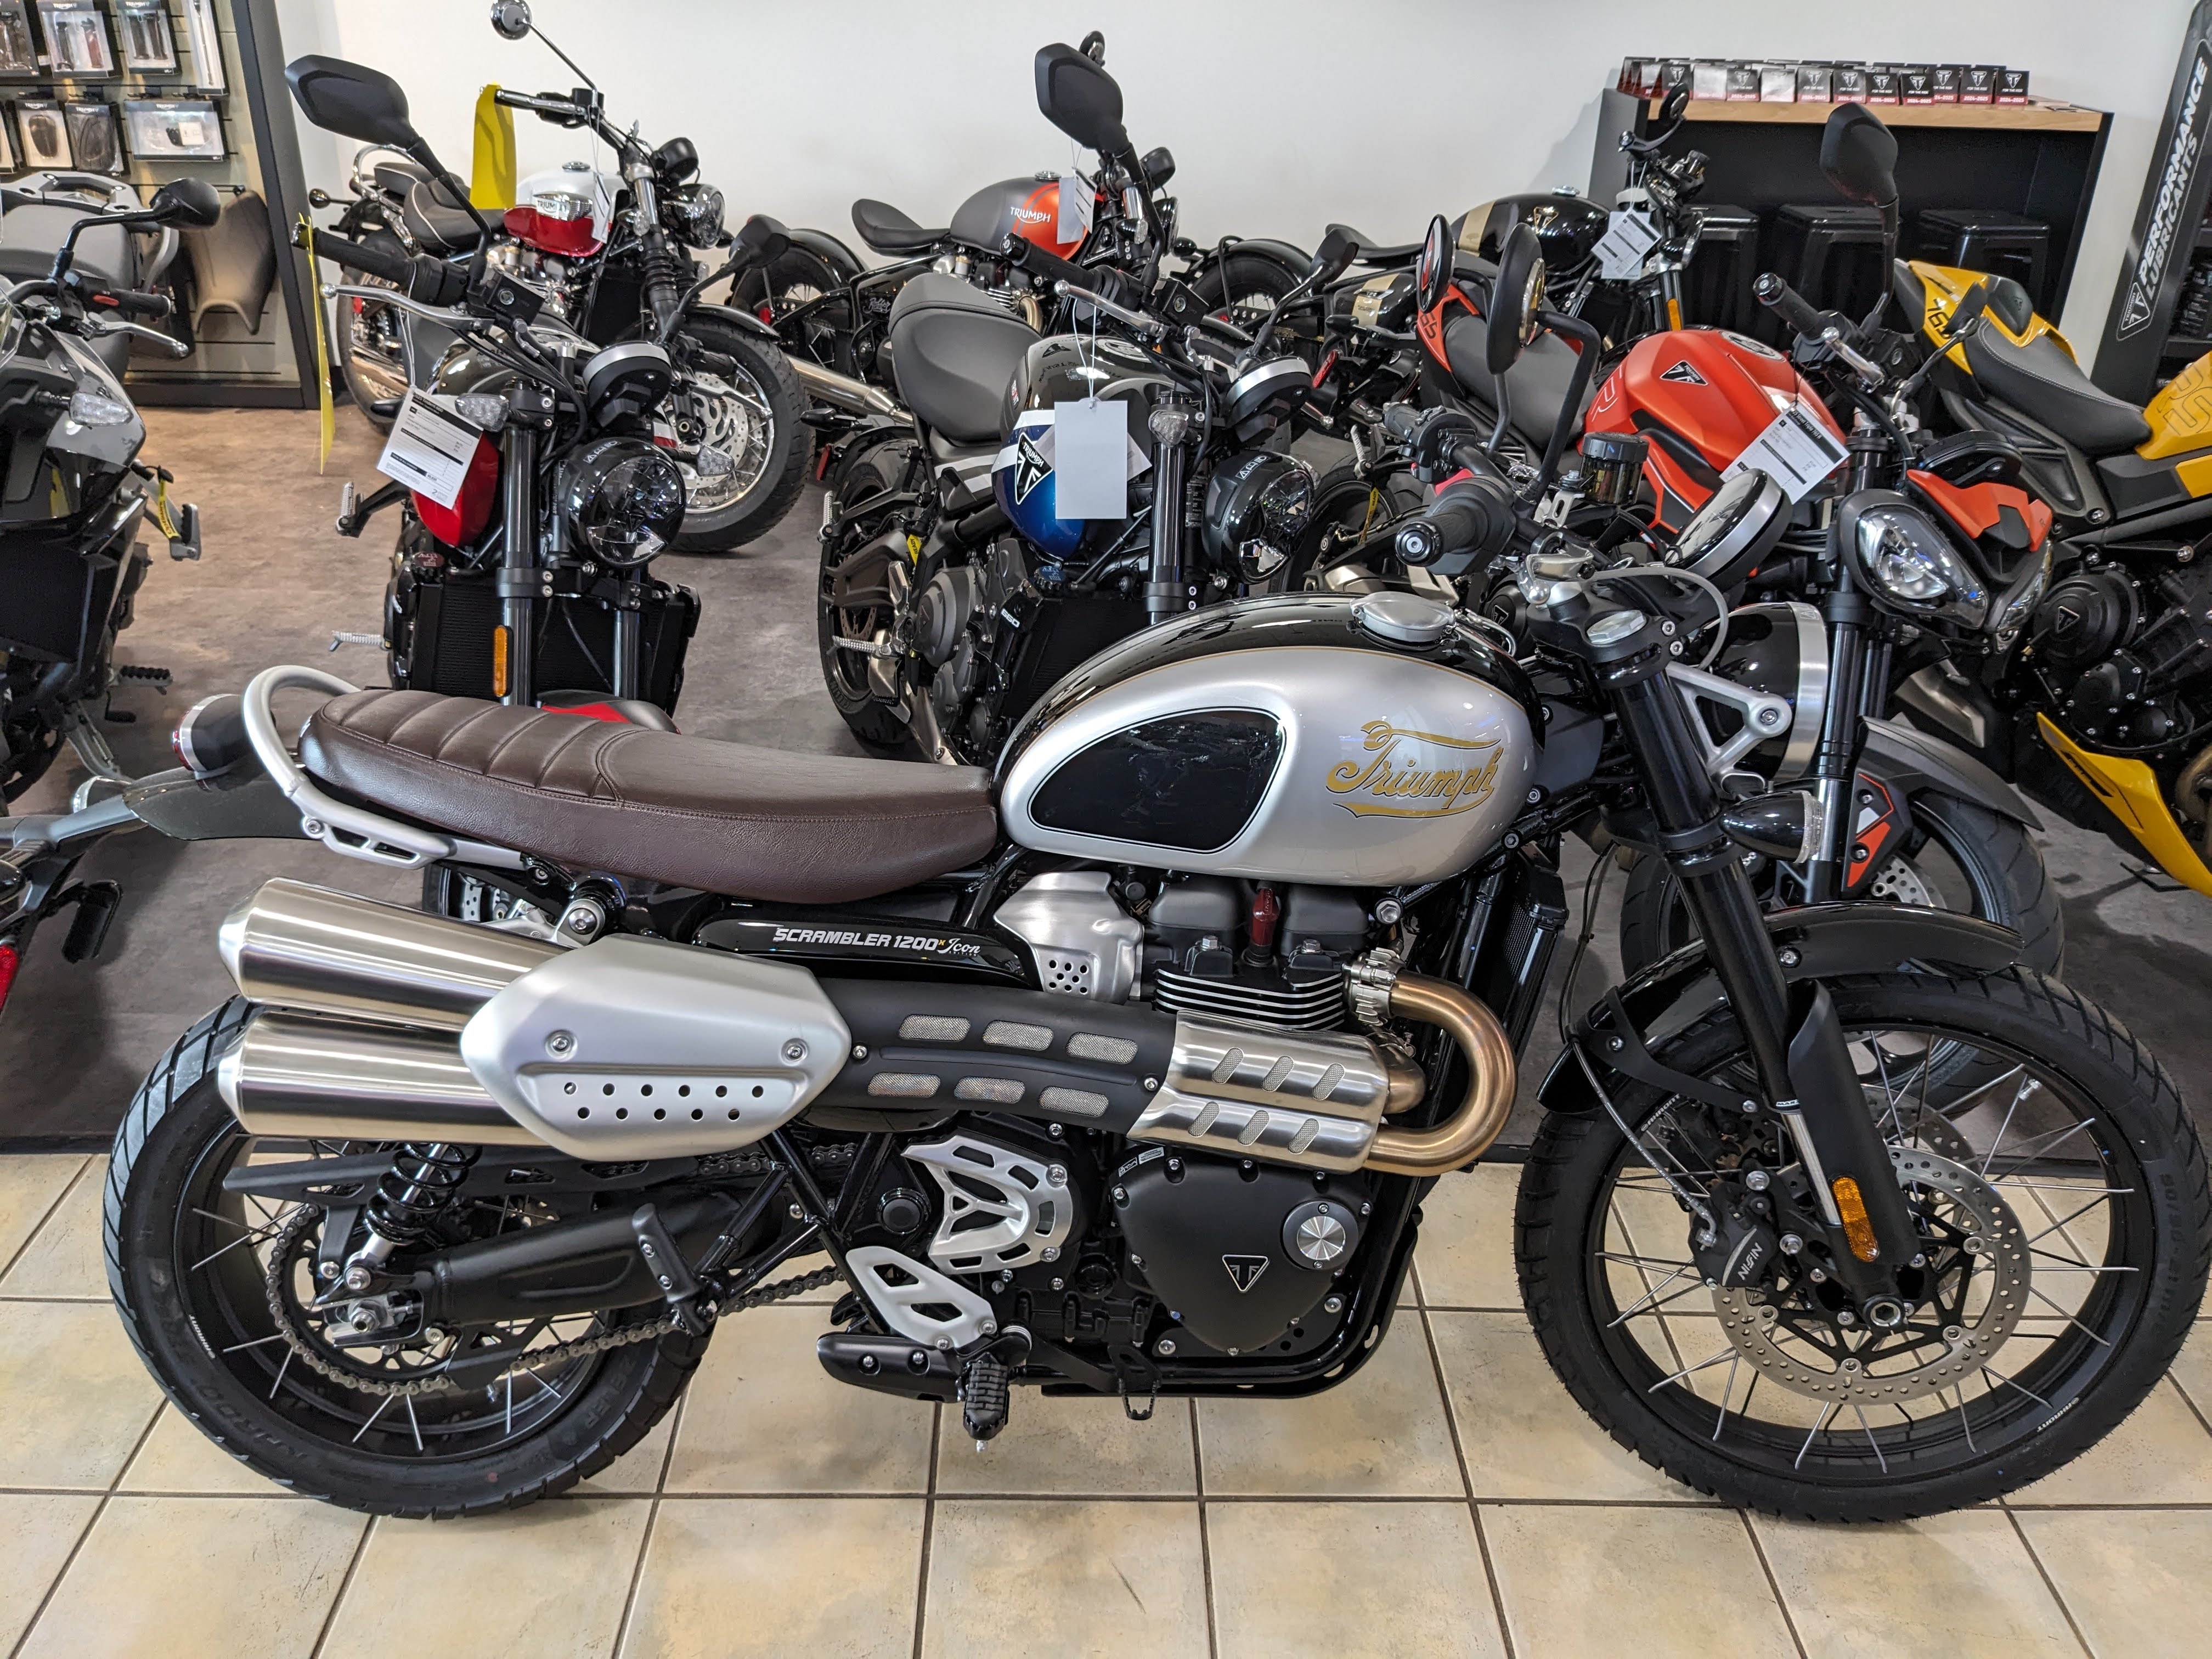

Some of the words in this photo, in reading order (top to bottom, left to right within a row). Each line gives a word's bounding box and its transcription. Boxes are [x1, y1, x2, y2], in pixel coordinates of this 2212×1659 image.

[2139, 57, 2208, 286] PERFORMANCE
[1011, 206, 1051, 223] TRIUMPH
[2146, 132, 2197, 300] LUBRICANTS
[2125, 292, 2136, 321] TRIUMPH
[1684, 365, 1701, 381] TRIUMPH
[422, 398, 436, 408] Trident
[1796, 413, 1807, 424] Street
[1802, 421, 1814, 433] Triple
[1811, 428, 1819, 437] 765
[1023, 441, 1045, 467] TRIUMPH
[1001, 608, 1020, 628] 660
[1326, 720, 1504, 819] Triumph
[773, 928, 891, 947] SCRAMBLER
[937, 938, 981, 954] Icon
[1738, 1242, 1763, 1280] NISSIN
